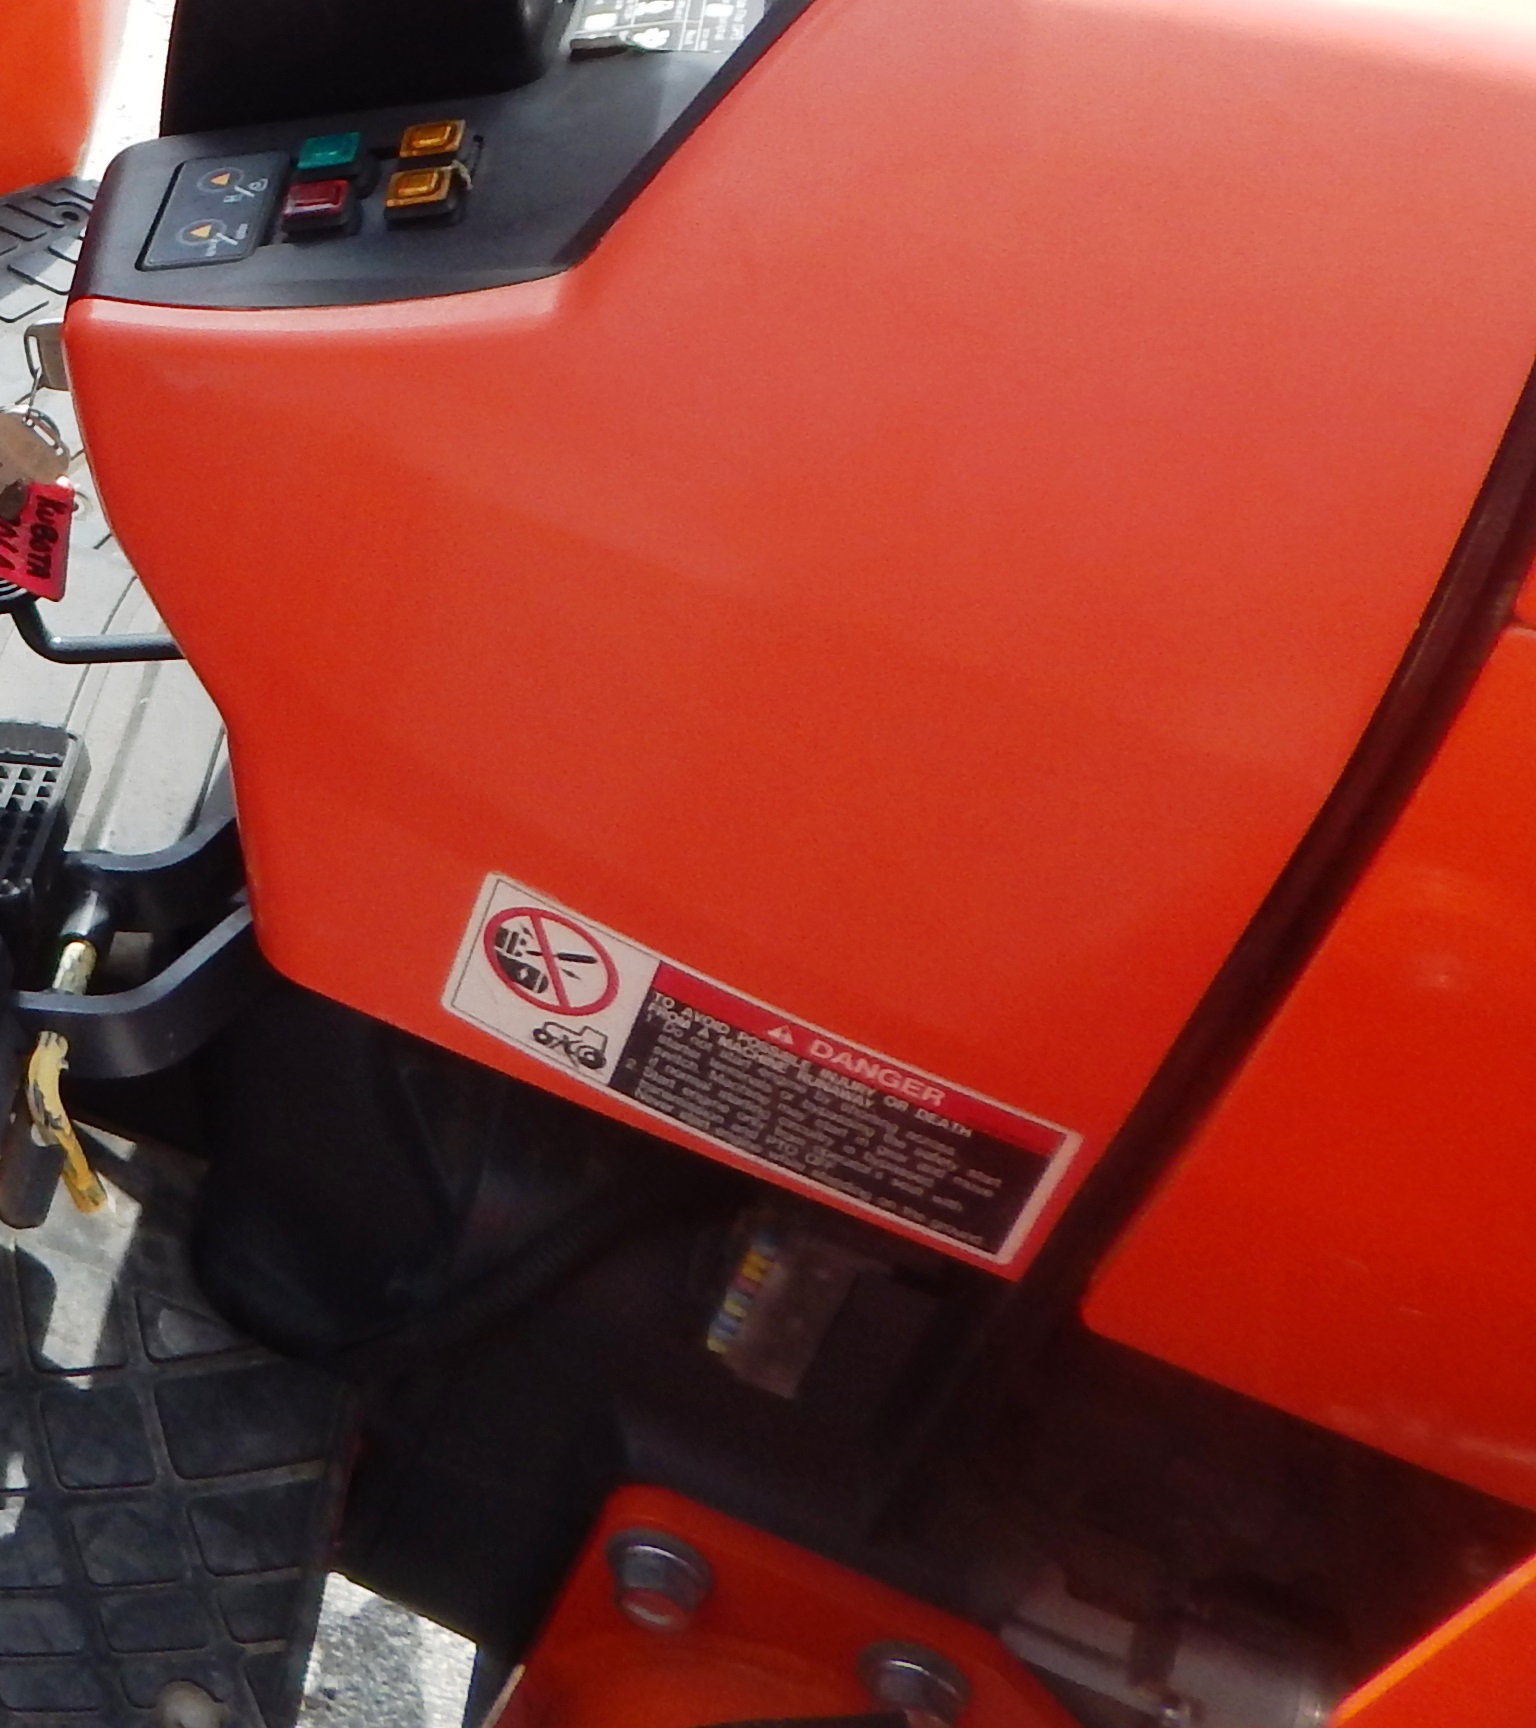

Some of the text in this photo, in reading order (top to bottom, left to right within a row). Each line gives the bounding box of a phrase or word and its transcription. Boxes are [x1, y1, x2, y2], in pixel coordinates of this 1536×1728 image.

[651, 992, 676, 1010] TO
[680, 1006, 731, 1035] AVOID
[914, 1106, 974, 1139] DEATH
[807, 1037, 946, 1108] DANGER
